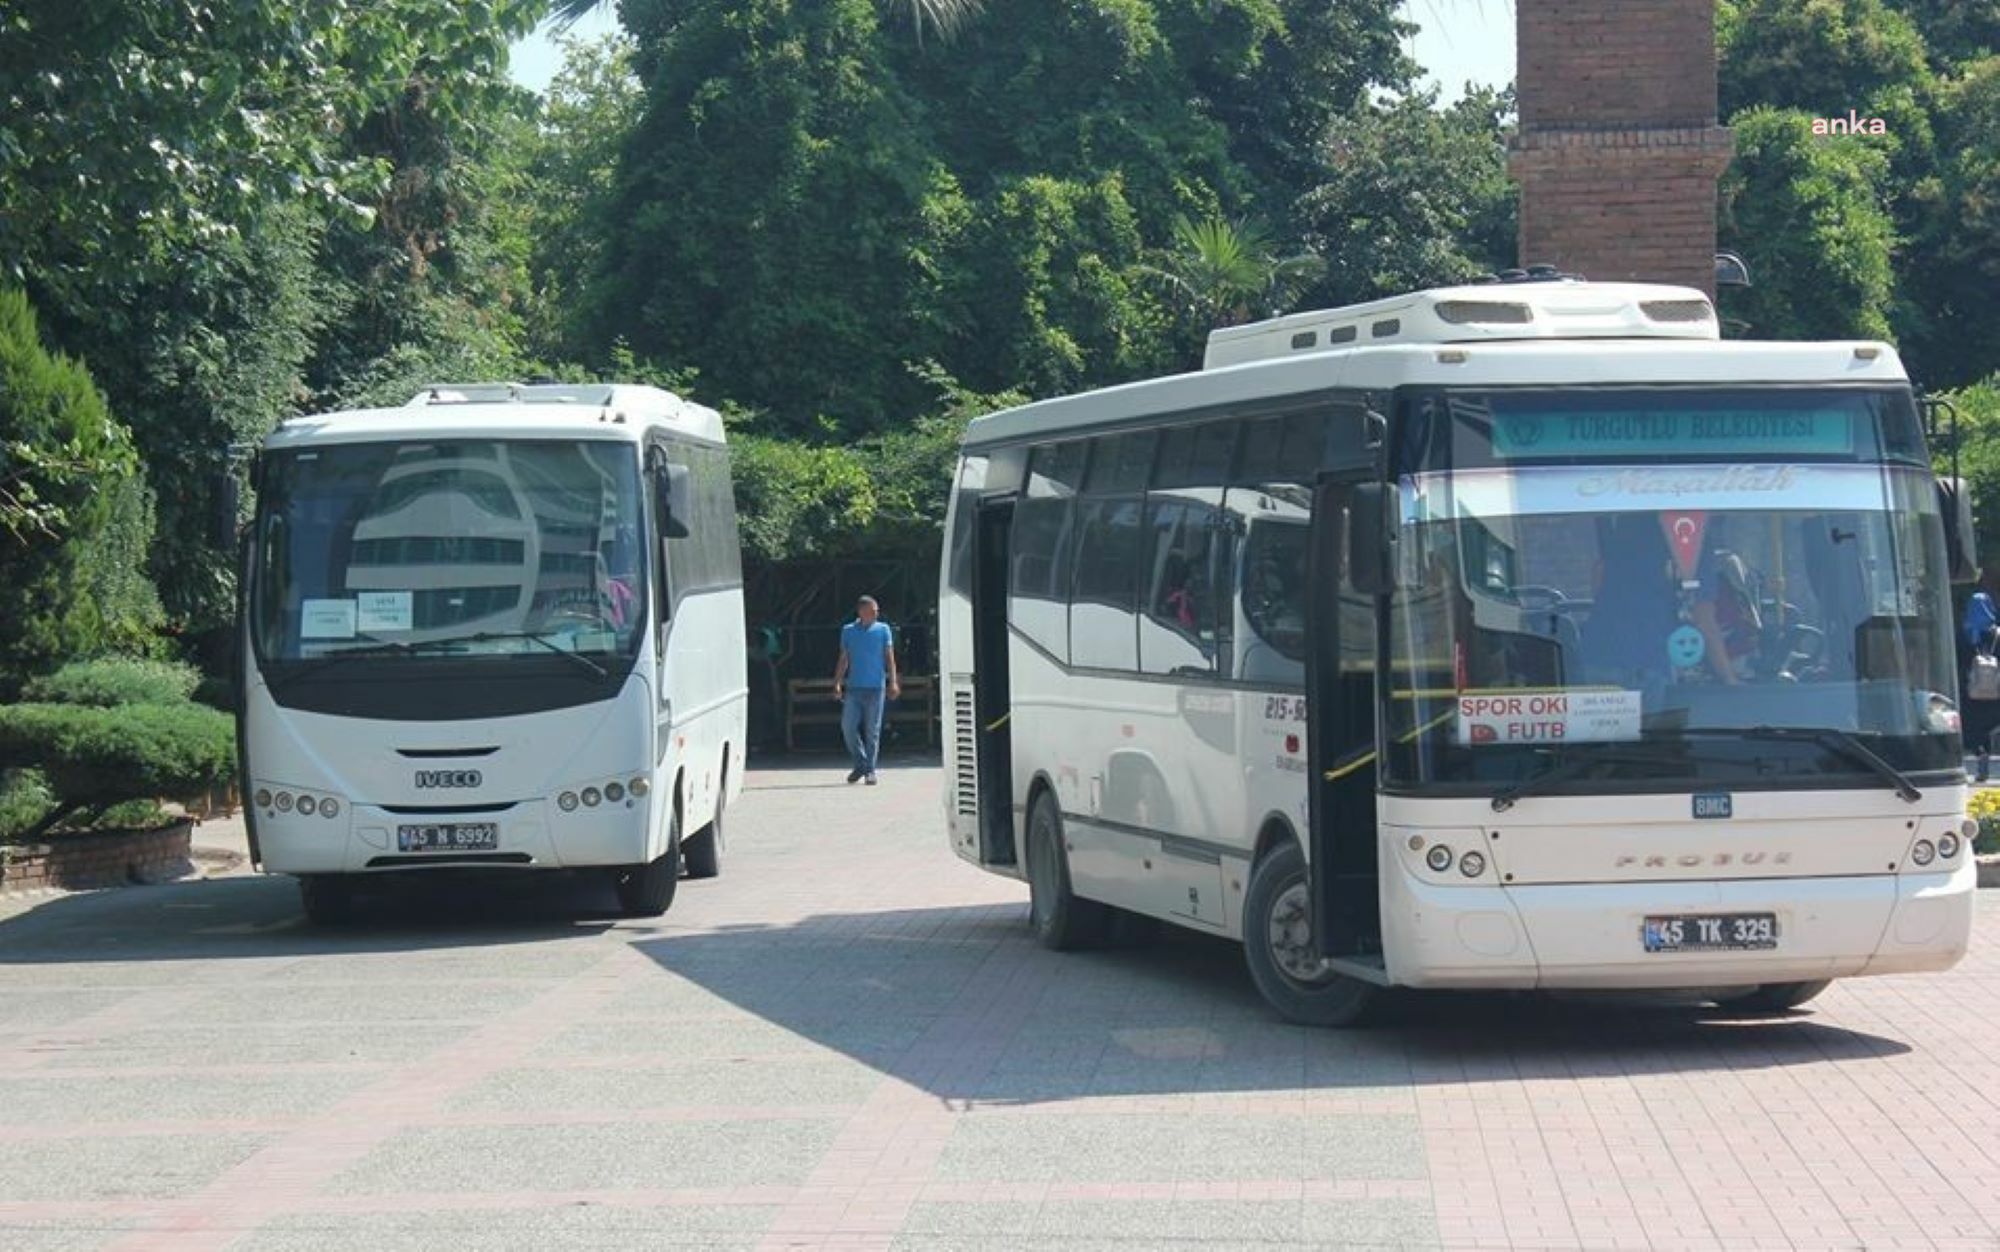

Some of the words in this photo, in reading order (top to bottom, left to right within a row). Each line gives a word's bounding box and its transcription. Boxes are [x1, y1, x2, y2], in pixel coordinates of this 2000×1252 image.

[1566, 414, 1678, 441] TURGUTLU
[1461, 697, 1523, 717] SPOR
[1508, 721, 1566, 741] FUTB
[415, 770, 482, 788] IVECO
[1696, 797, 1730, 815] BMC
[1660, 921, 1684, 943] 45
[1697, 919, 1722, 942] TK
[1734, 918, 1771, 941] 329
